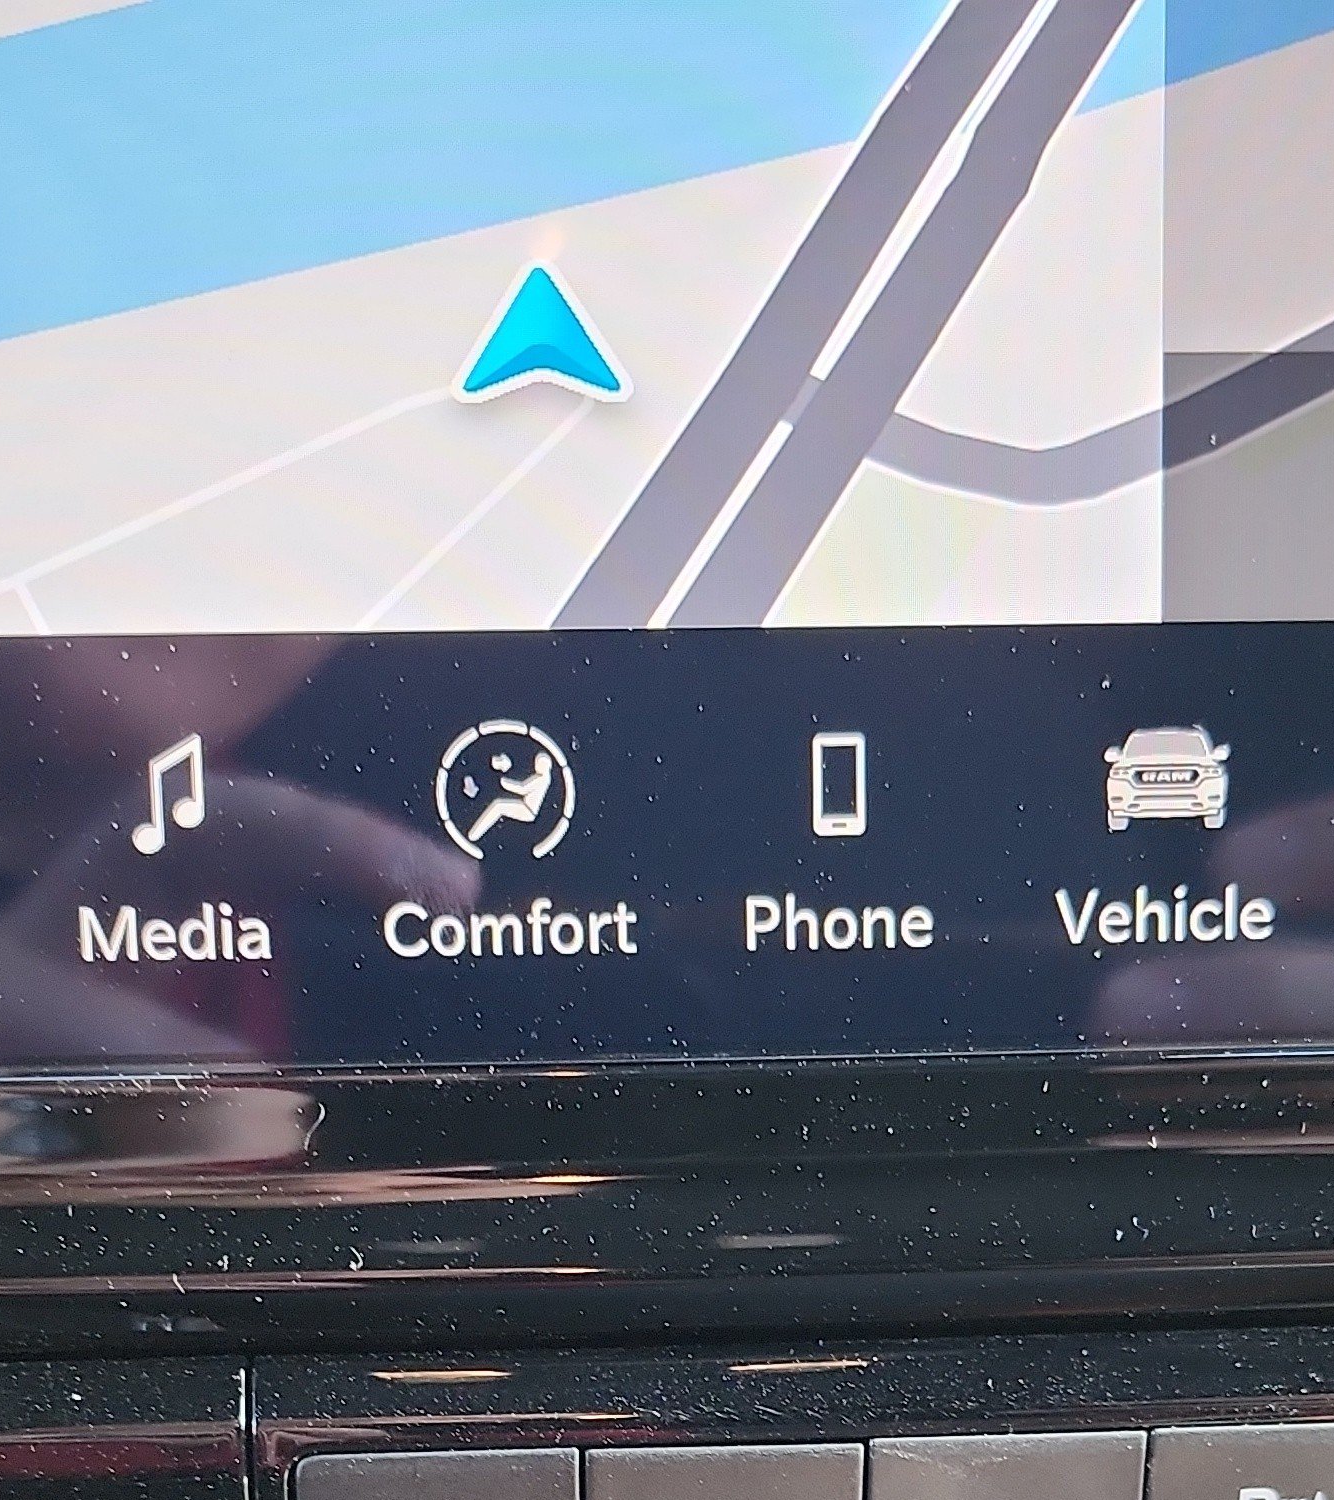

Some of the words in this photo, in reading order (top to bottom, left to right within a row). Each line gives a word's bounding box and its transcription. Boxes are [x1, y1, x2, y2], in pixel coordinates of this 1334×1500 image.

[77, 902, 273, 962] Media
[383, 897, 638, 958] Comfort
[745, 892, 934, 952] Phone
[1054, 883, 1275, 945] Vehicle
